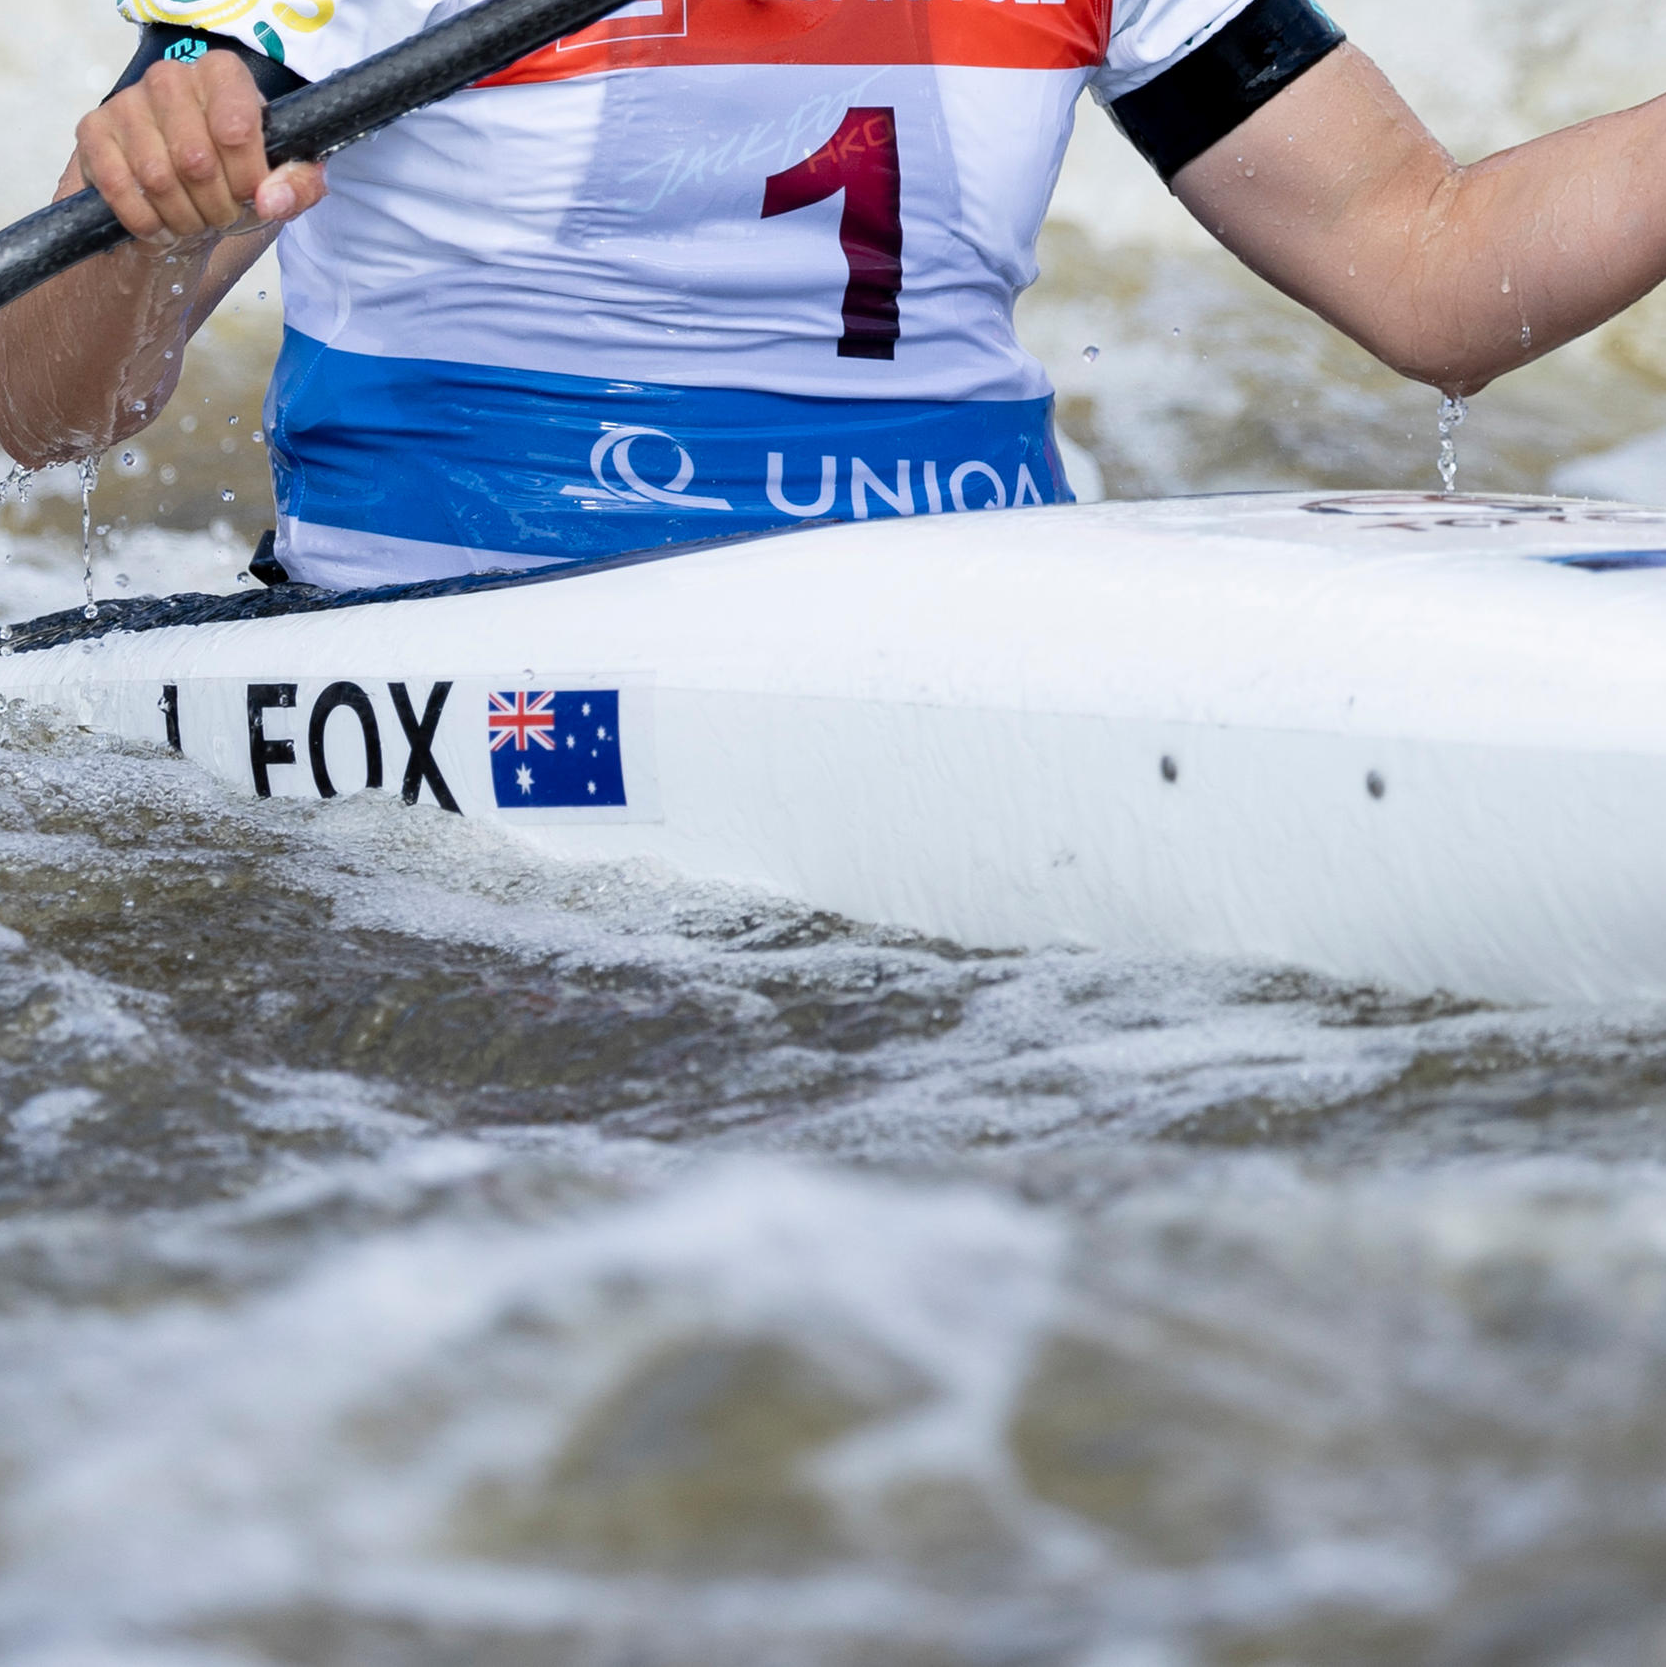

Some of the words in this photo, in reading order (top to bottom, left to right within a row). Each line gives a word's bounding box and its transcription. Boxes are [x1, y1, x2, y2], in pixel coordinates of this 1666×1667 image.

[759, 106, 903, 361] 1
[765, 451, 1045, 520] UNIQA
[245, 680, 466, 818] FOX
